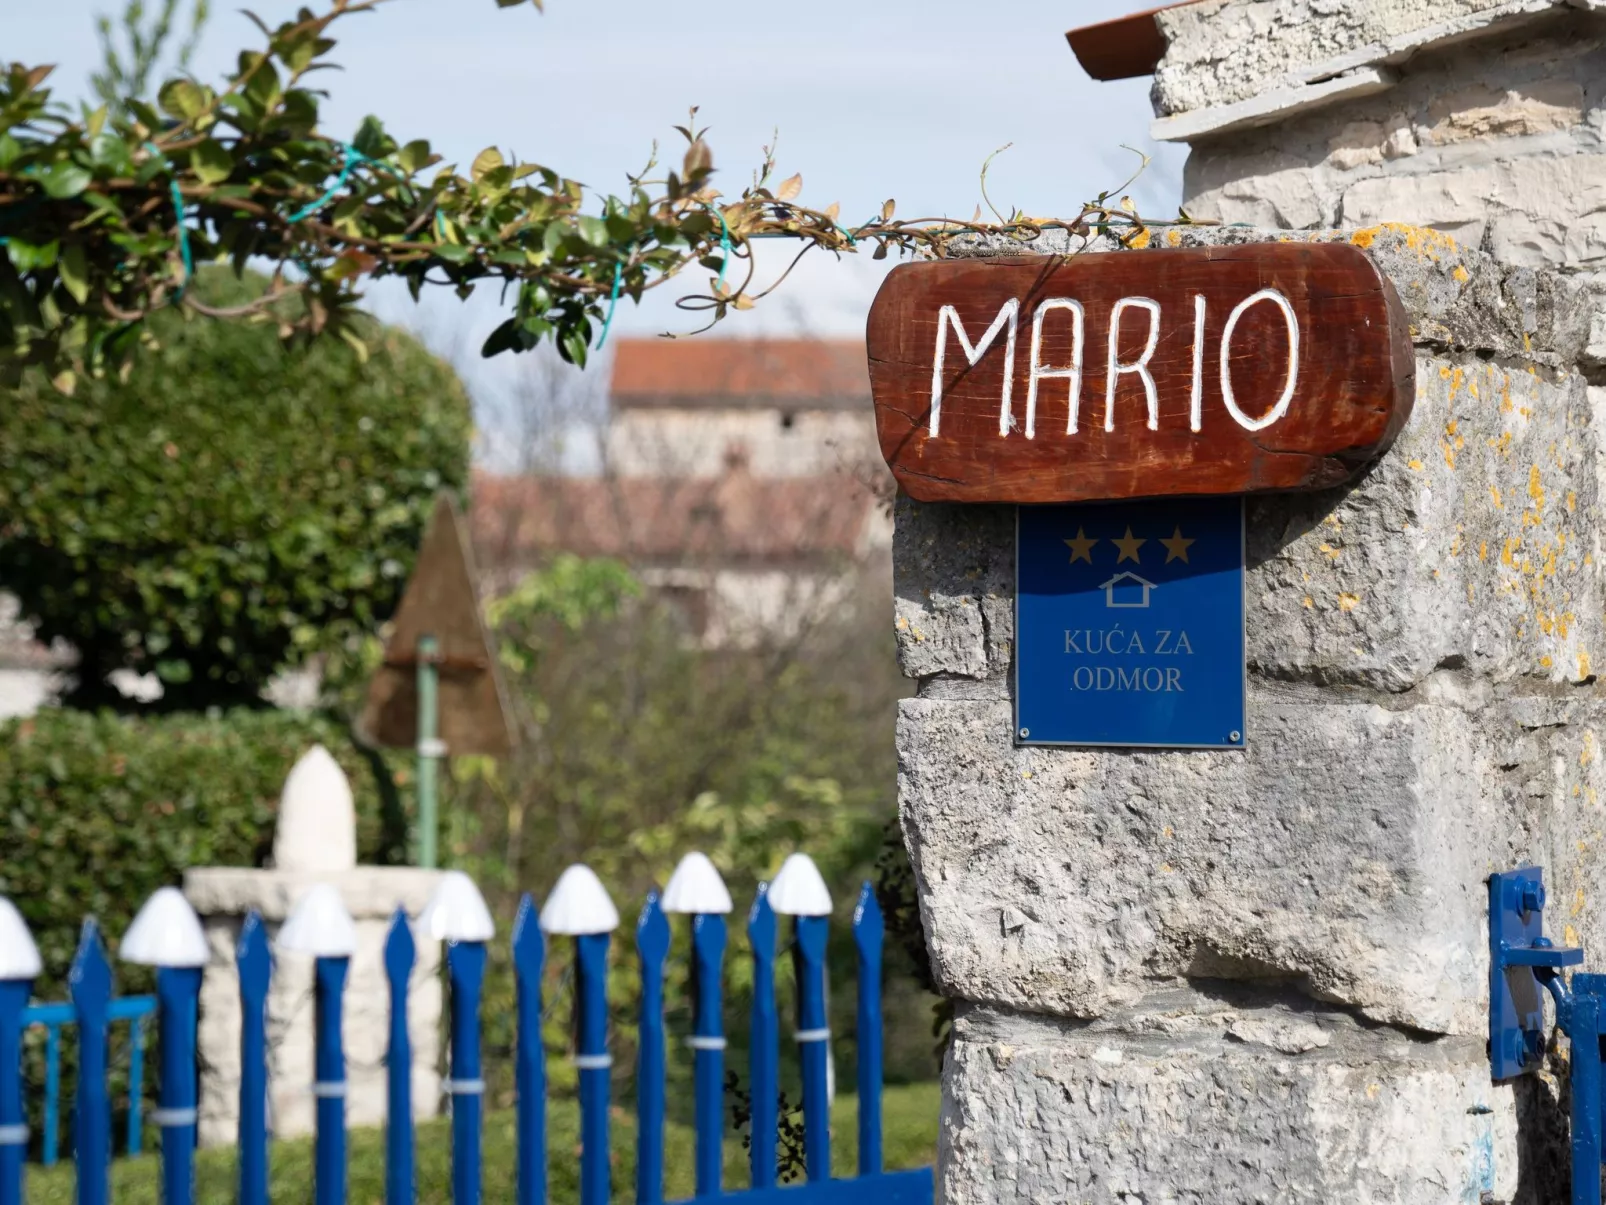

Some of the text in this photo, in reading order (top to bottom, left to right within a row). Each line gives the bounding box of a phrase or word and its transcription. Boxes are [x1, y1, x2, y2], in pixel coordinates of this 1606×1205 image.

[929, 287, 1300, 439] MARIO
[1063, 622, 1195, 655] KUĆA ZA
[1072, 665, 1185, 693] ODMOR
